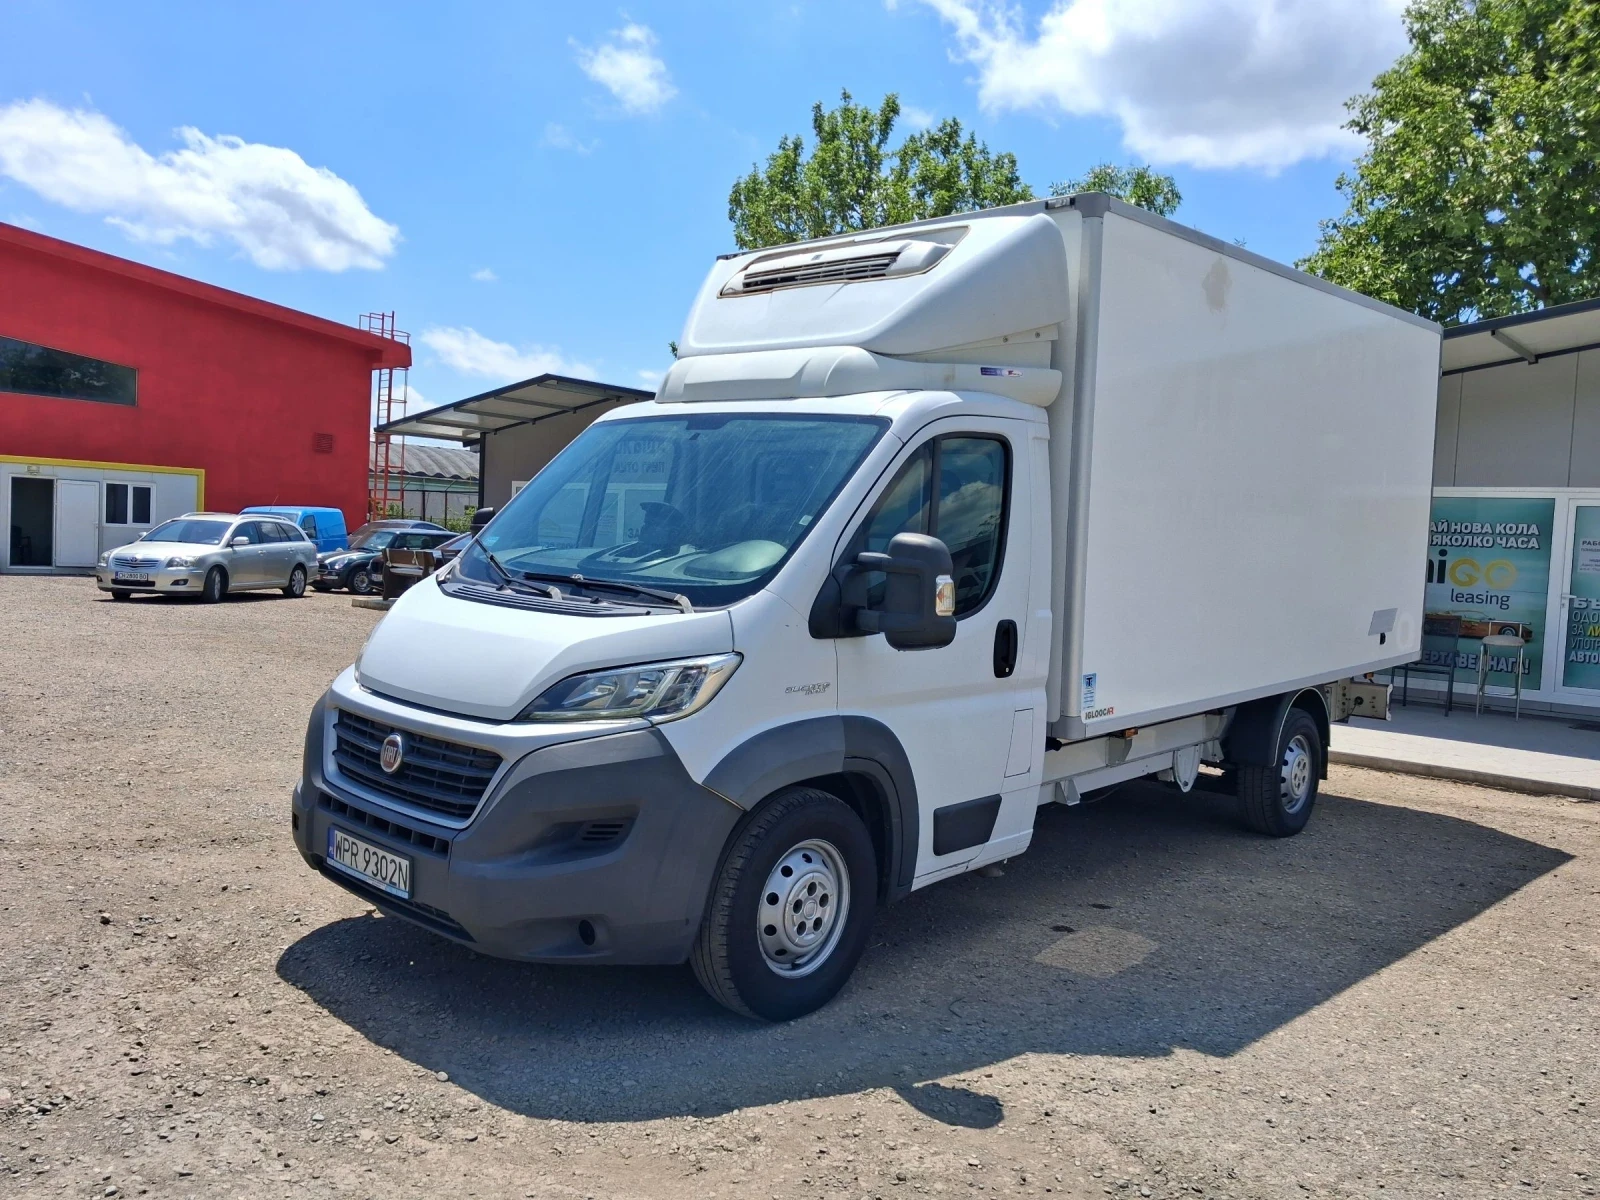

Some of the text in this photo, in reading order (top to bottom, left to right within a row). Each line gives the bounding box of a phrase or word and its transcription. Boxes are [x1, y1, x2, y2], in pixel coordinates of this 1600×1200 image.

[1451, 522, 1492, 534] НОВА
[1496, 523, 1539, 535] КОЛА
[1429, 534, 1539, 549] ЯКОЛКО ЧАСА
[1451, 588, 1511, 610] leasing
[1572, 610, 1600, 624] ОДО
[1571, 624, 1584, 636] ЗА
[1569, 650, 1600, 663] АВТО
[1085, 707, 1114, 720] IGLOOCAR
[335, 833, 408, 890] WPR 9302N
